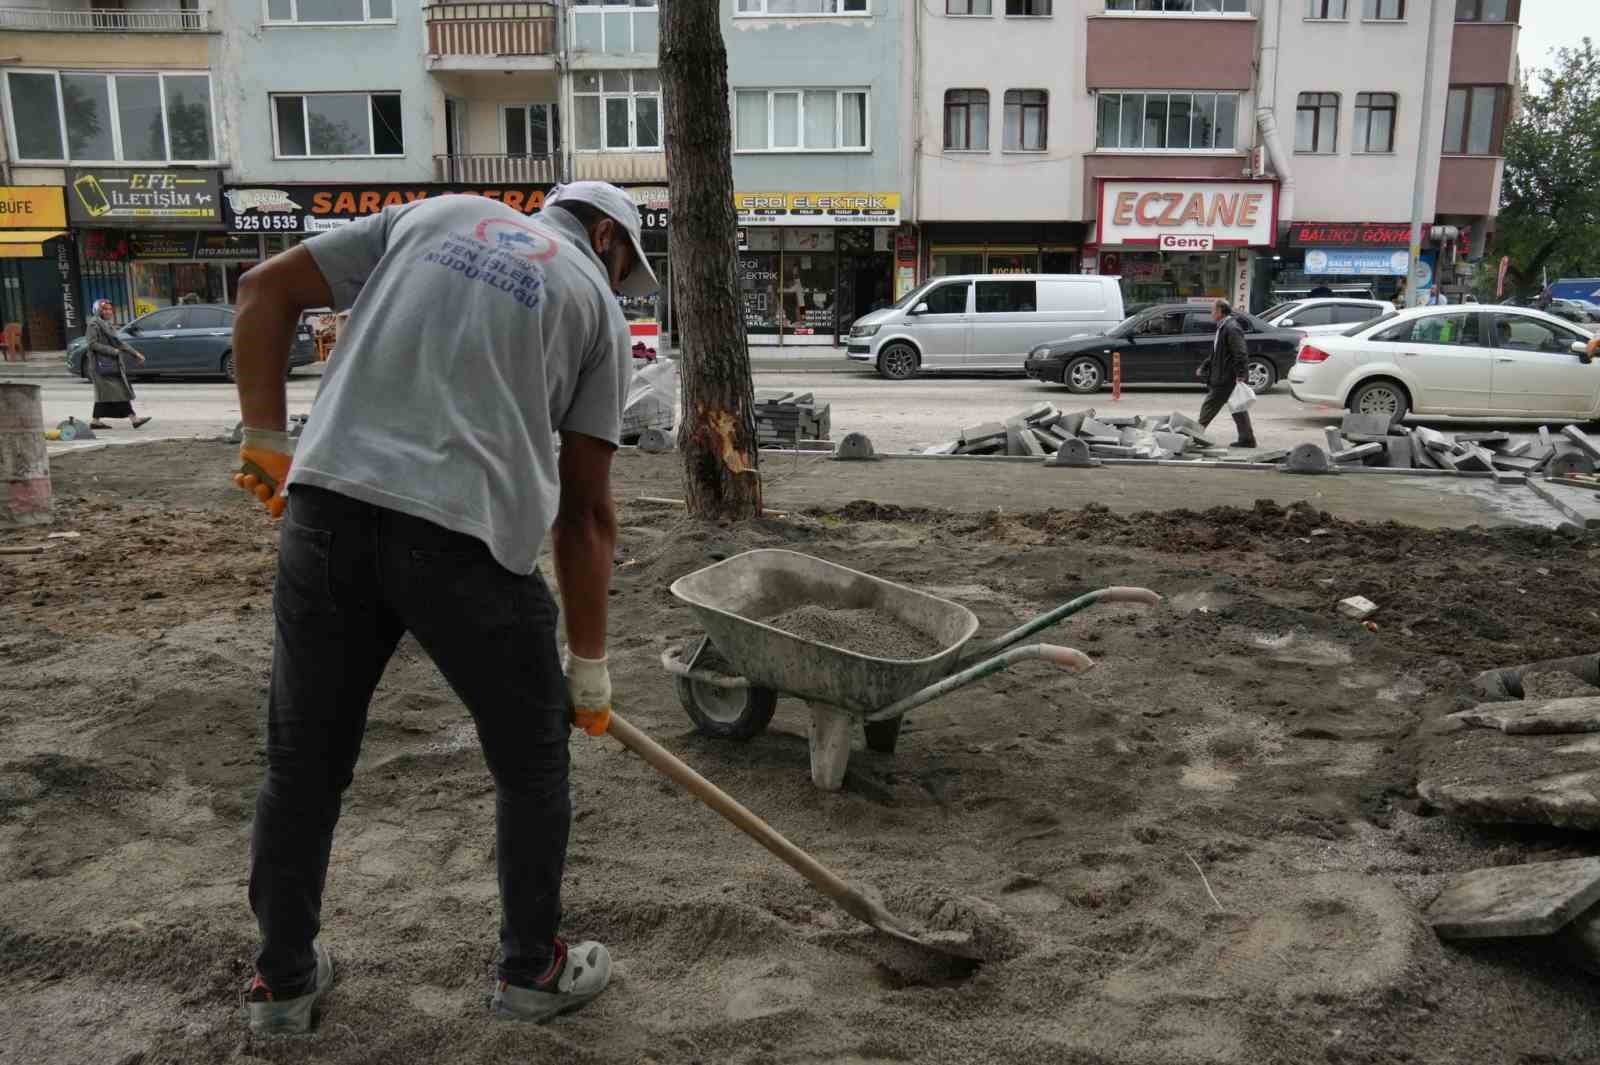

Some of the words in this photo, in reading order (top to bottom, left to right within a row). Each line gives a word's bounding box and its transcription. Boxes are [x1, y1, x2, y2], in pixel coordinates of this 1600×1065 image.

[129, 174, 177, 189] EFE
[112, 190, 191, 207] İLETİŞİM
[1112, 191, 1263, 226] ECZANE
[235, 216, 260, 230] 525
[262, 216, 271, 230] 0
[273, 216, 298, 230] 535
[1163, 236, 1209, 250] Genç
